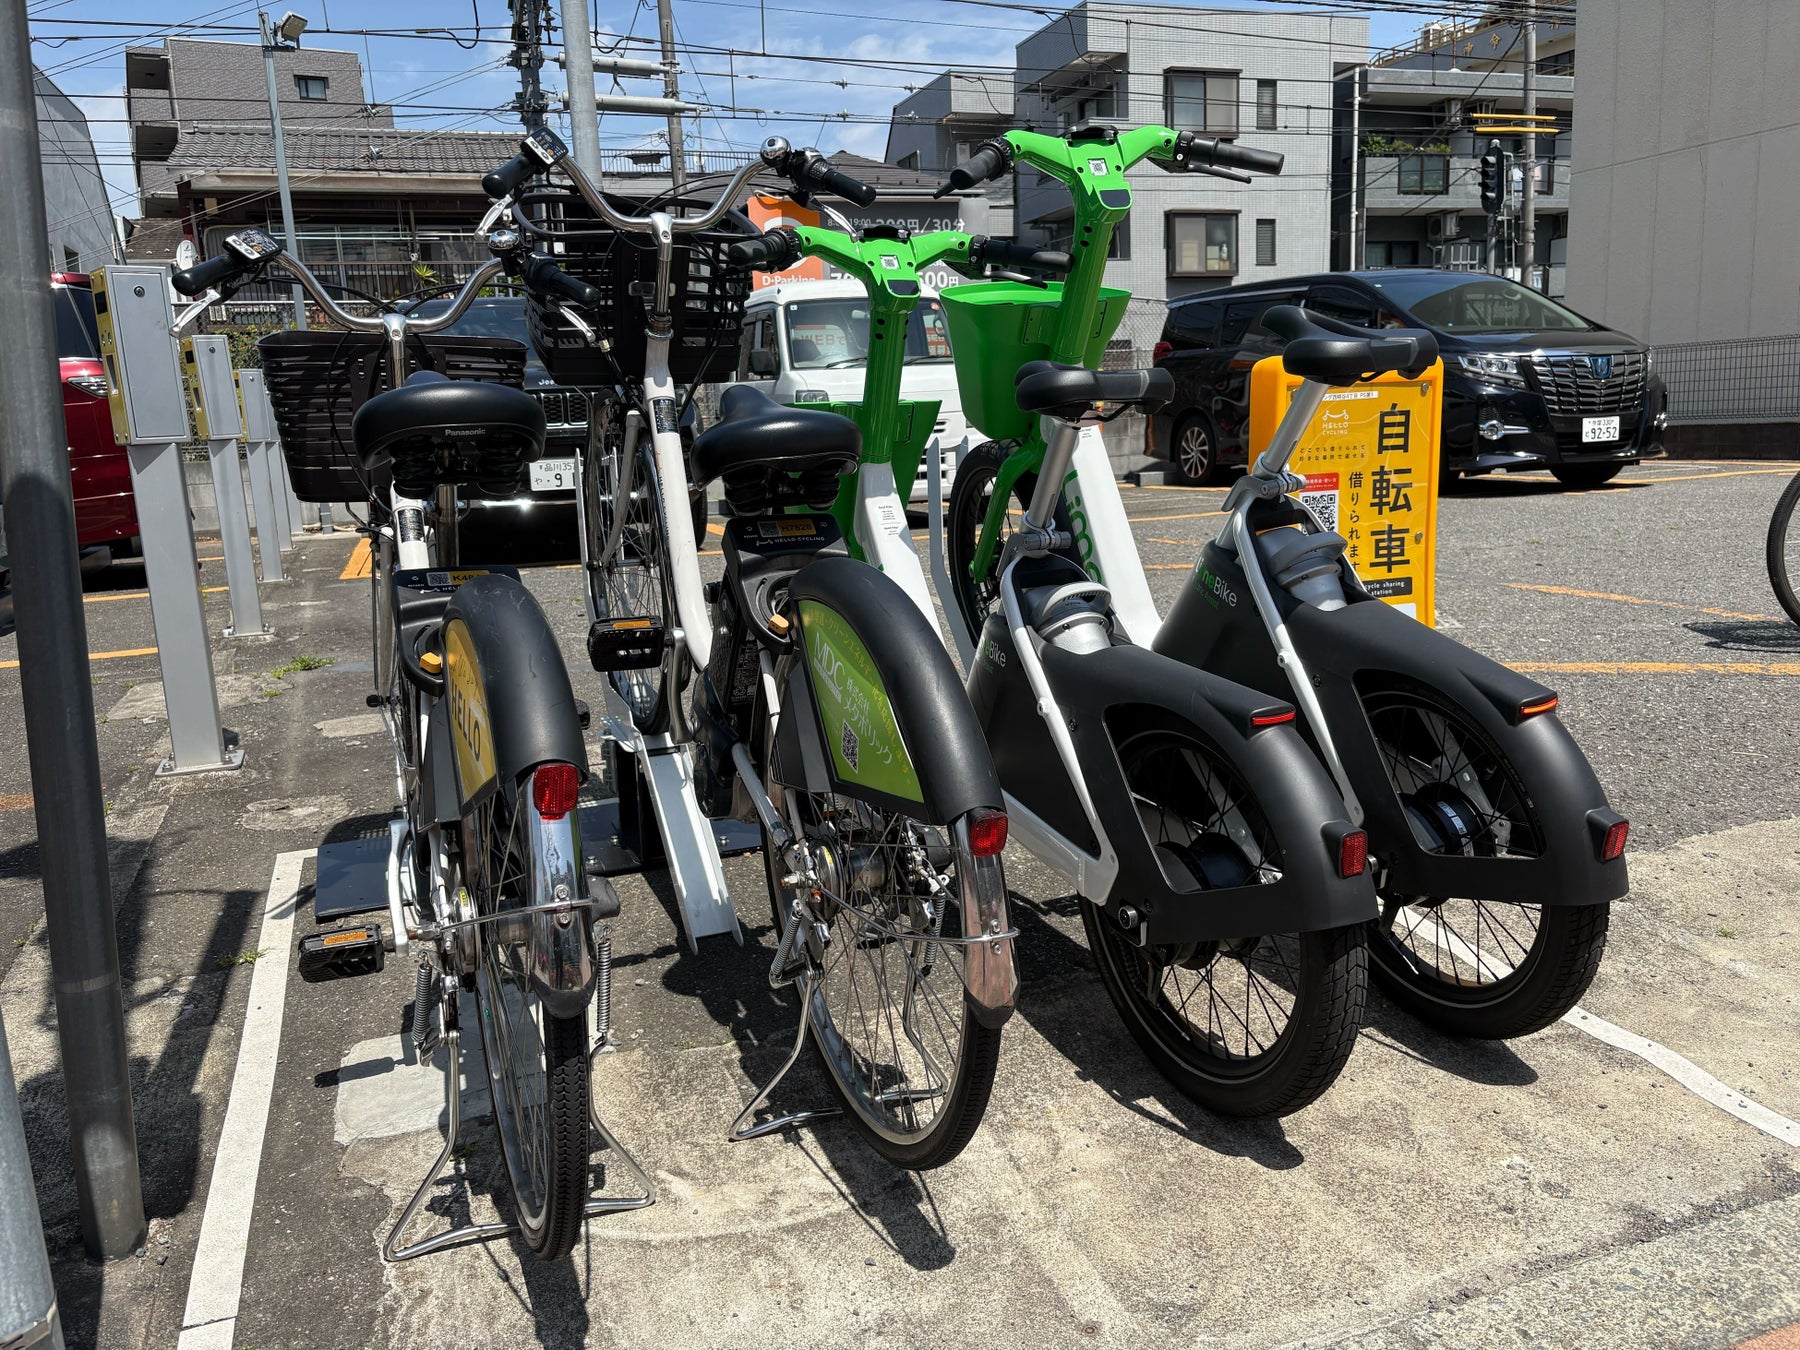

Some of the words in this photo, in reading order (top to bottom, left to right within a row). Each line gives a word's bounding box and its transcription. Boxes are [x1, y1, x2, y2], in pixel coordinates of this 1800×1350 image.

[445, 427, 486, 436] Panasonic
[1591, 426, 1617, 440] 92-52
[544, 463, 562, 472] 品川
[562, 462, 575, 471] 35
[1369, 402, 1412, 574] 自転車
[1365, 582, 1380, 590] cycle
[1382, 580, 1406, 589] sharing
[1371, 588, 1393, 596] station
[813, 631, 846, 691] MDC
[451, 678, 481, 762] HELLO
